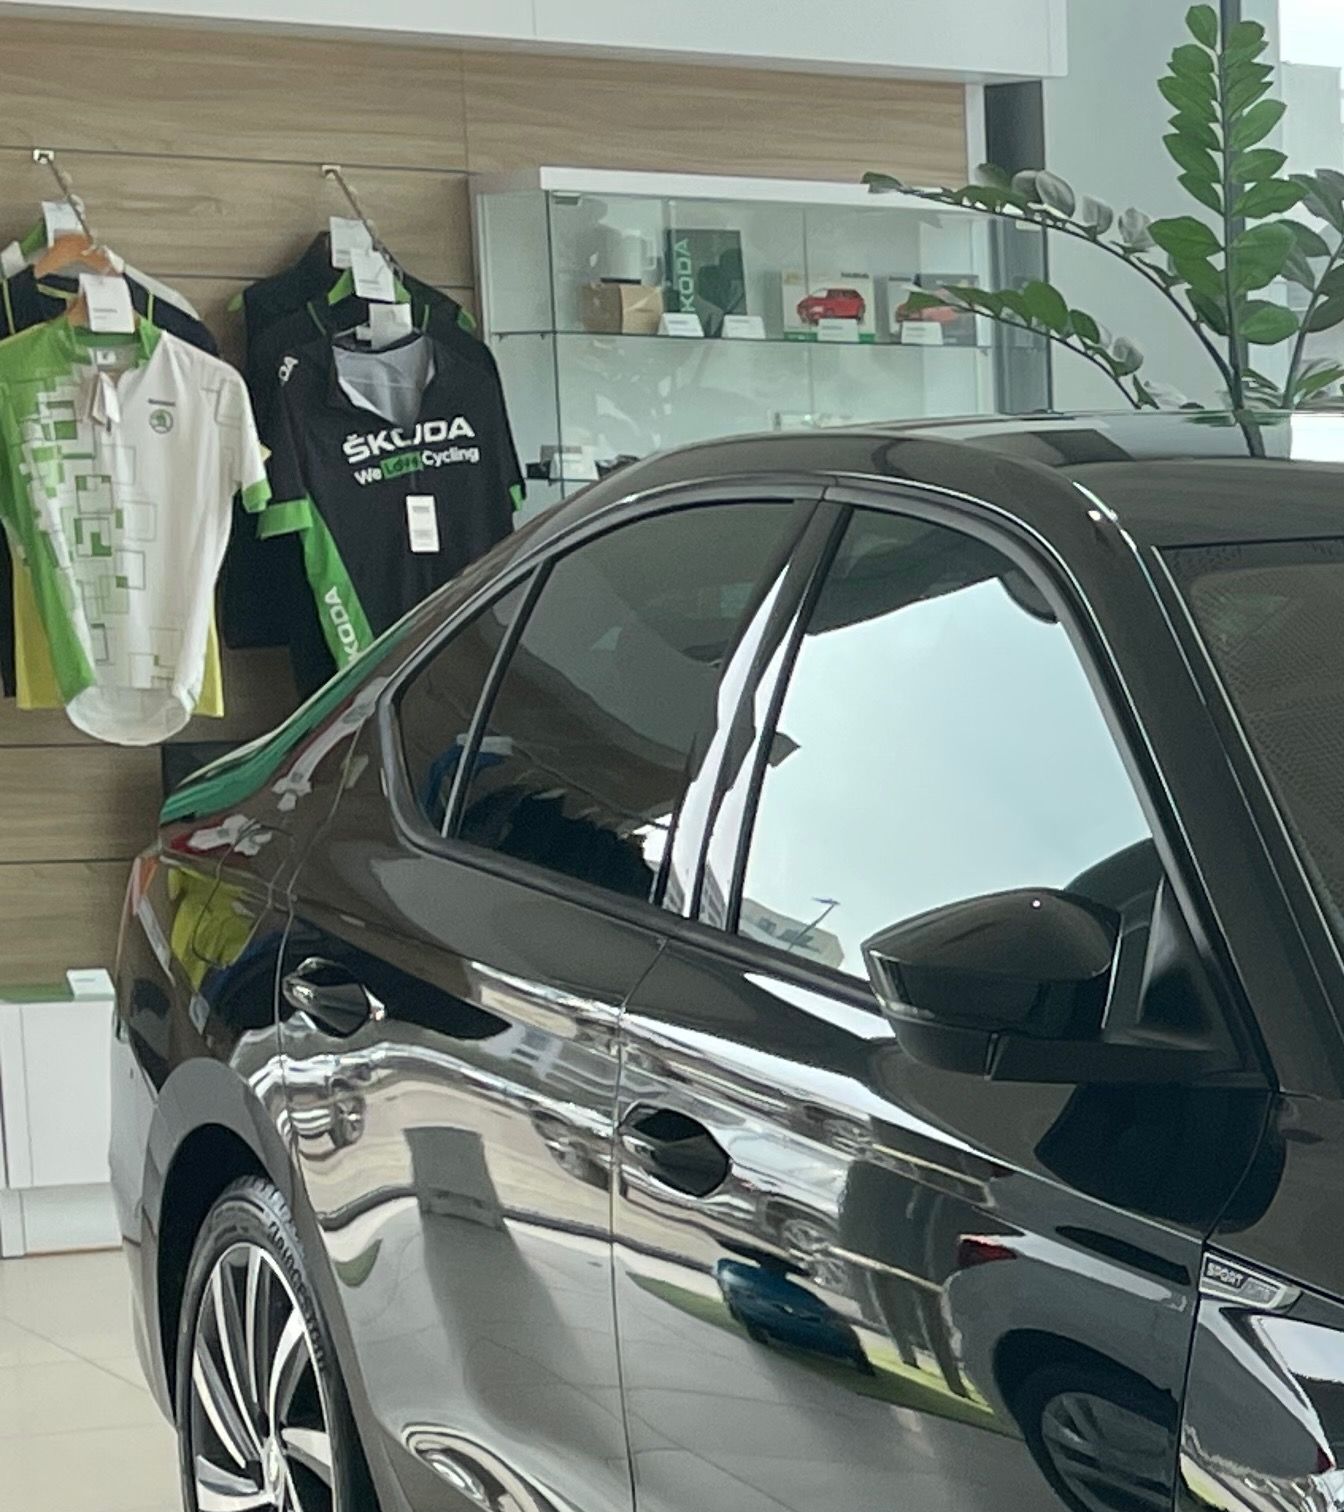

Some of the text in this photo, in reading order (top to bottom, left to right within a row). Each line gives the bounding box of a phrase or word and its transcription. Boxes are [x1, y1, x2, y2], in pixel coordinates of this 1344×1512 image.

[674, 238, 696, 312] KODA
[354, 467, 382, 485] We
[422, 447, 480, 467] Cycling
[324, 585, 361, 662] KODA
